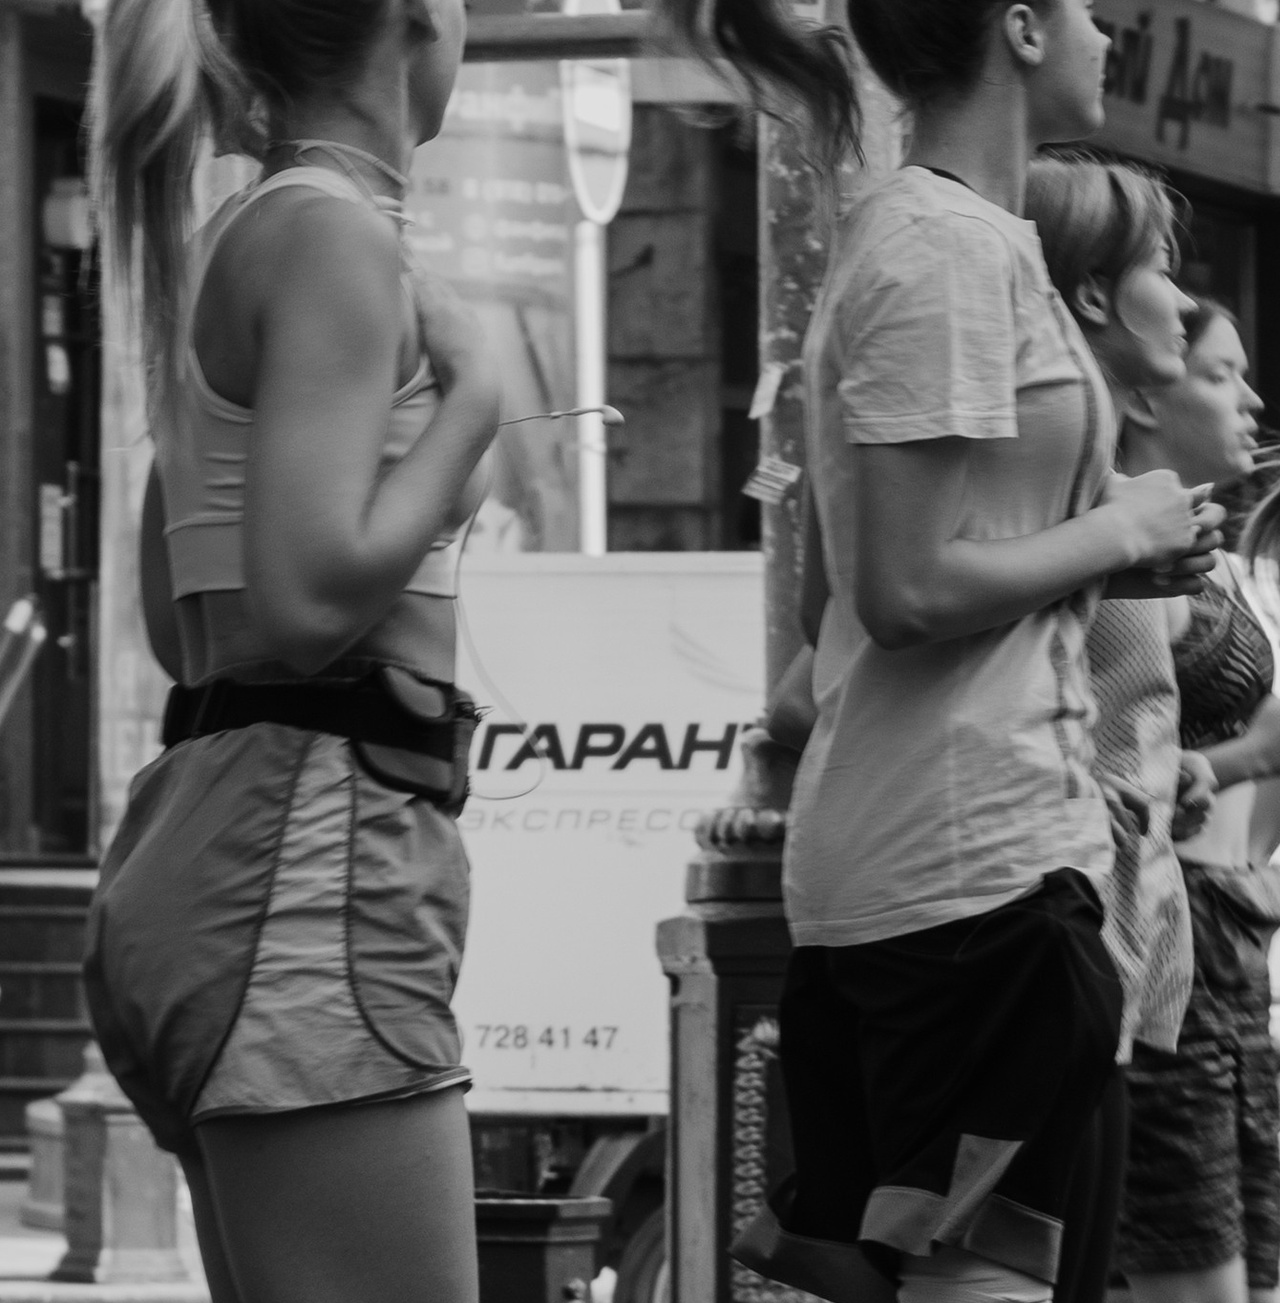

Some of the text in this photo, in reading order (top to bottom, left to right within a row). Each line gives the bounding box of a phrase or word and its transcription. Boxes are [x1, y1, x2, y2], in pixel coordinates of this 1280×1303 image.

[476, 723, 753, 770] ГАРАН
[475, 1024, 618, 1050] 728 41 47
